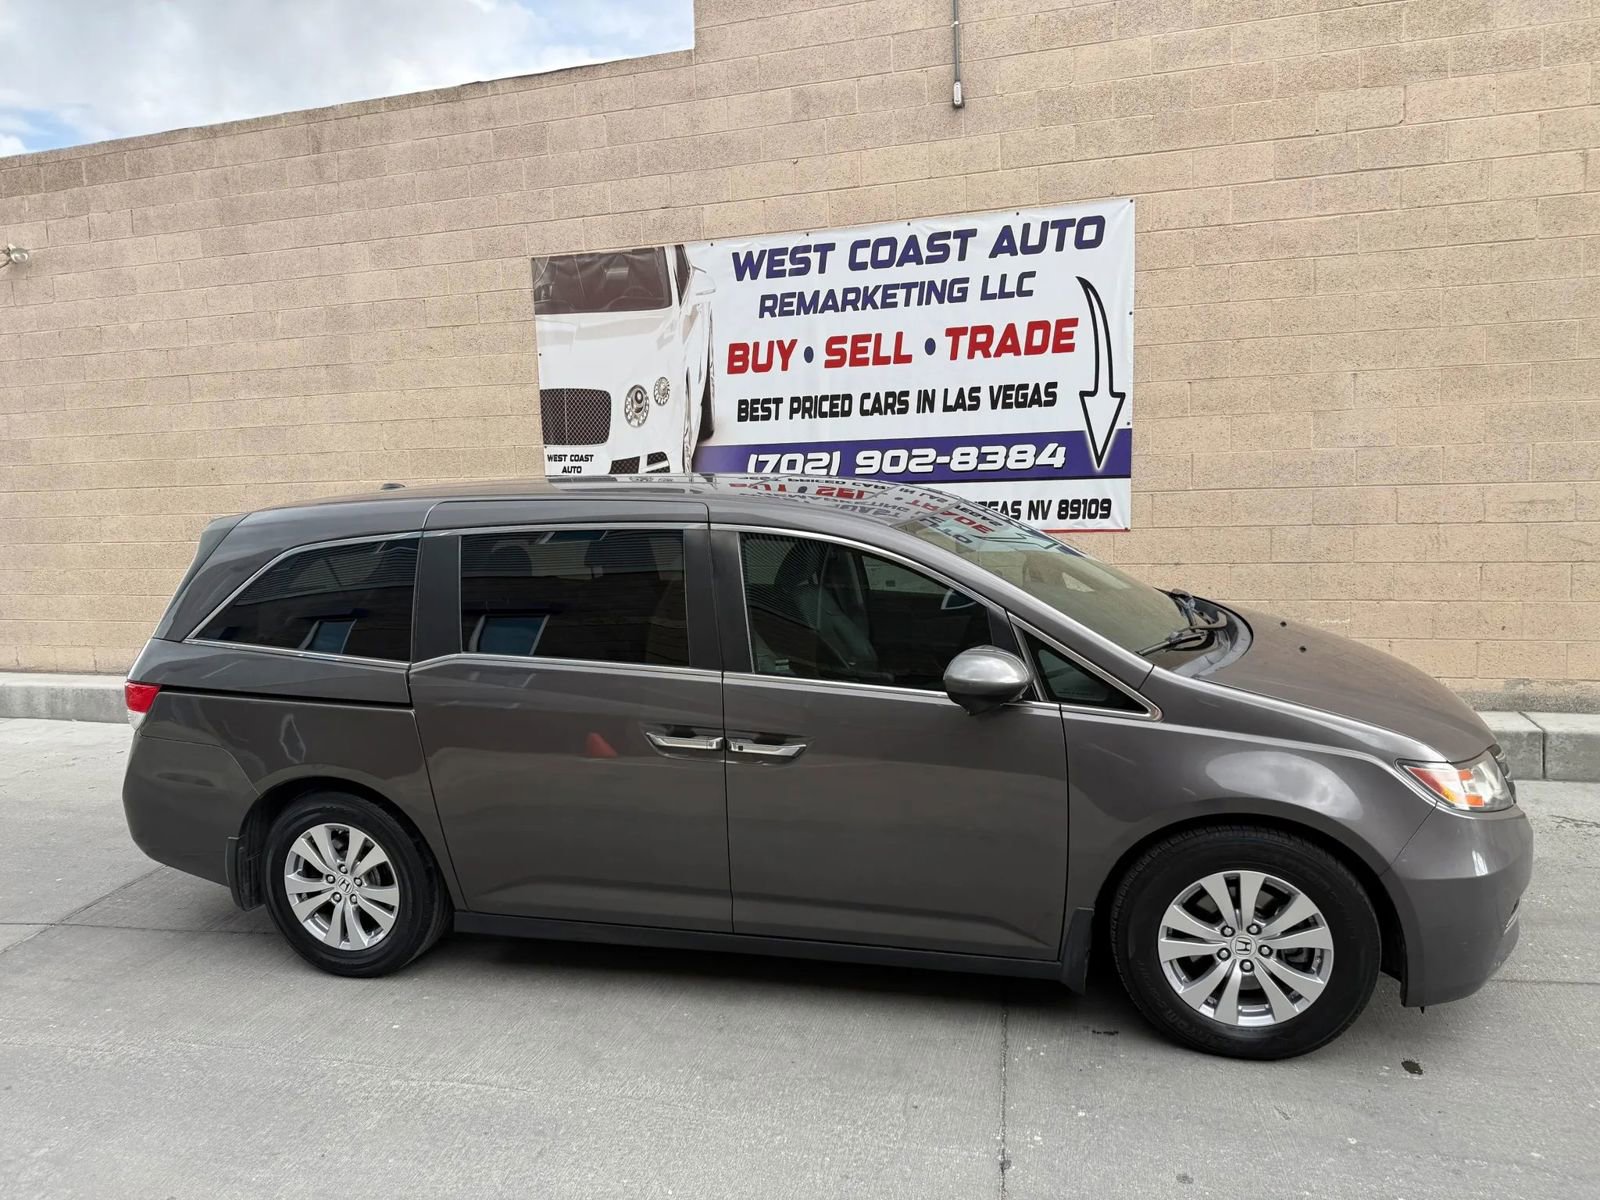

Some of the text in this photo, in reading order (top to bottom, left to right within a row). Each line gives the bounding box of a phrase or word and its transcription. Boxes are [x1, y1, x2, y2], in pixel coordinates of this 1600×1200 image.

[731, 215, 1106, 282] WEST COAST AUTO
[758, 270, 1037, 319] REMARKETING LLC
[727, 317, 1079, 375] BUY SELL TRADE
[737, 381, 1058, 423] BEST PRICED CARS IN LAS VEGAS
[547, 454, 594, 462] WEST COAST
[747, 443, 1067, 476] (702) 902-8384
[1027, 499, 1053, 521] NV
[1057, 498, 1112, 520] 89109
